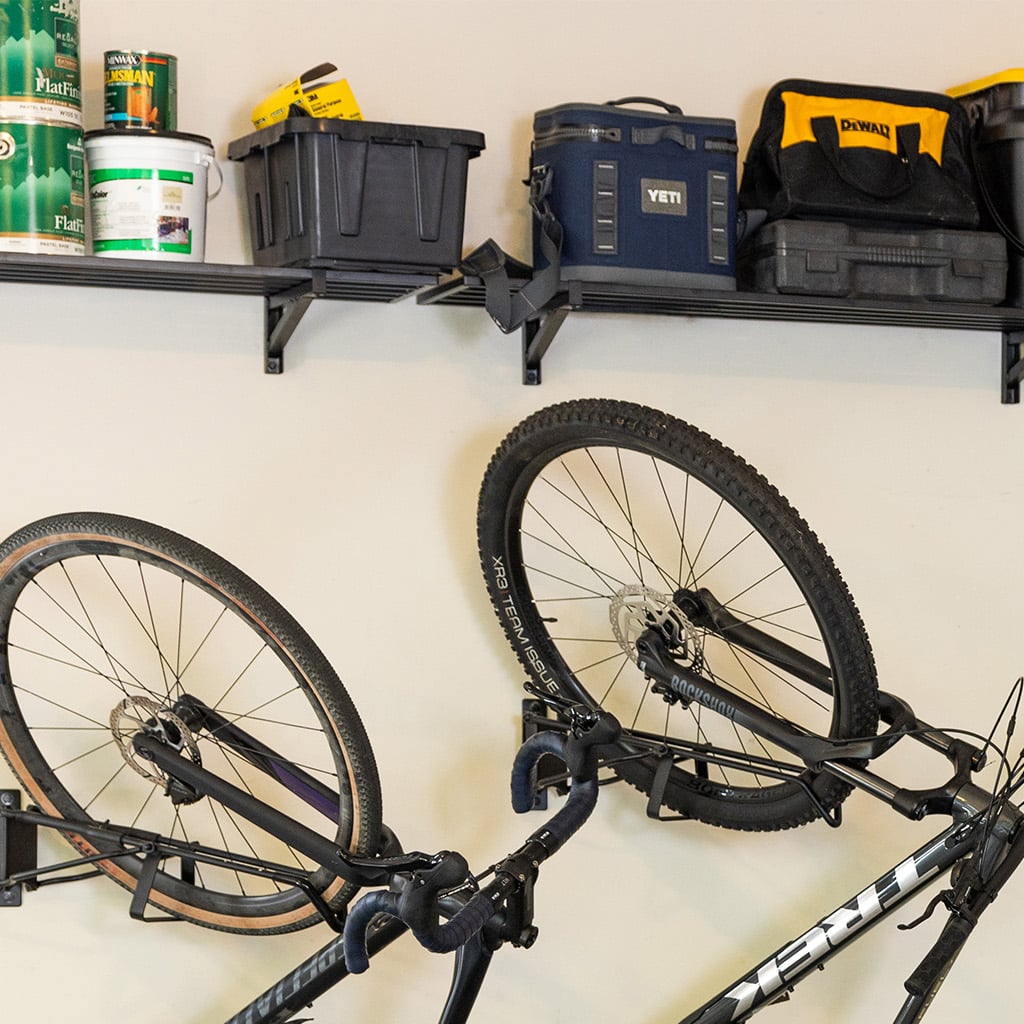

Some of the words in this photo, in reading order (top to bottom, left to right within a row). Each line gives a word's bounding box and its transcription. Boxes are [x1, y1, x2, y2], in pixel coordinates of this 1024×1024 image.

[840, 118, 891, 140] DEWALT
[647, 189, 681, 204] YETI
[492, 555, 509, 591] XR3
[502, 594, 531, 645] TEAM
[524, 645, 561, 696] ISSUE
[671, 674, 737, 719] ROCKSHOX
[724, 855, 940, 1021] TREK
